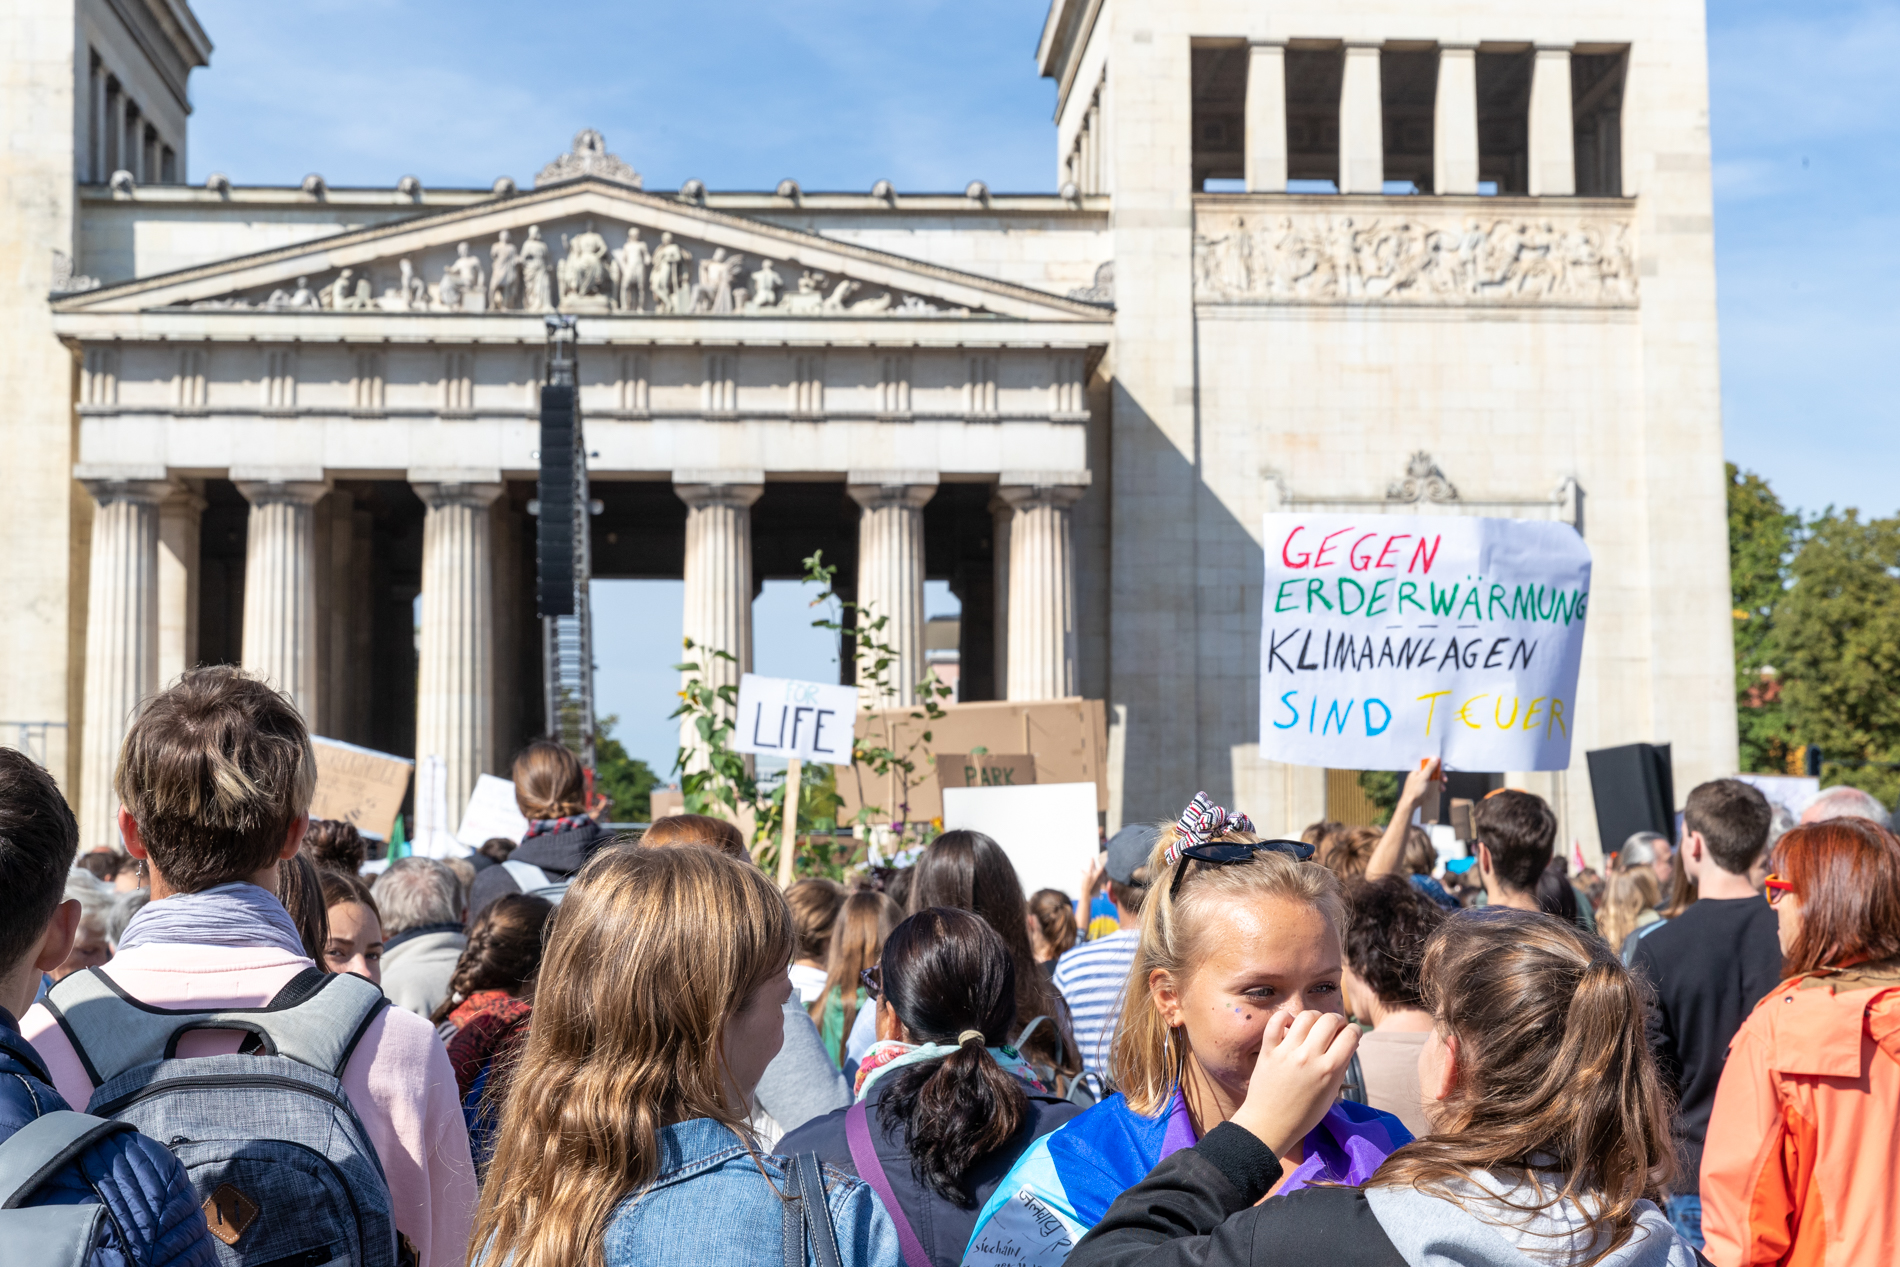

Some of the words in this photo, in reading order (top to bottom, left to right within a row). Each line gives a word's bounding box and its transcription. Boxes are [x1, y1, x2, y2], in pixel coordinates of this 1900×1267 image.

[1281, 526, 1442, 574] GEGEN
[1273, 574, 1587, 626] ERDERWÄRMUNG
[1268, 628, 1539, 674] KLIMAANLAGEN
[785, 681, 819, 705] FOR
[1273, 690, 1393, 737] SIND
[1416, 689, 1567, 740] T€UER
[753, 702, 836, 753] LIFE
[964, 765, 1015, 787] PARK
